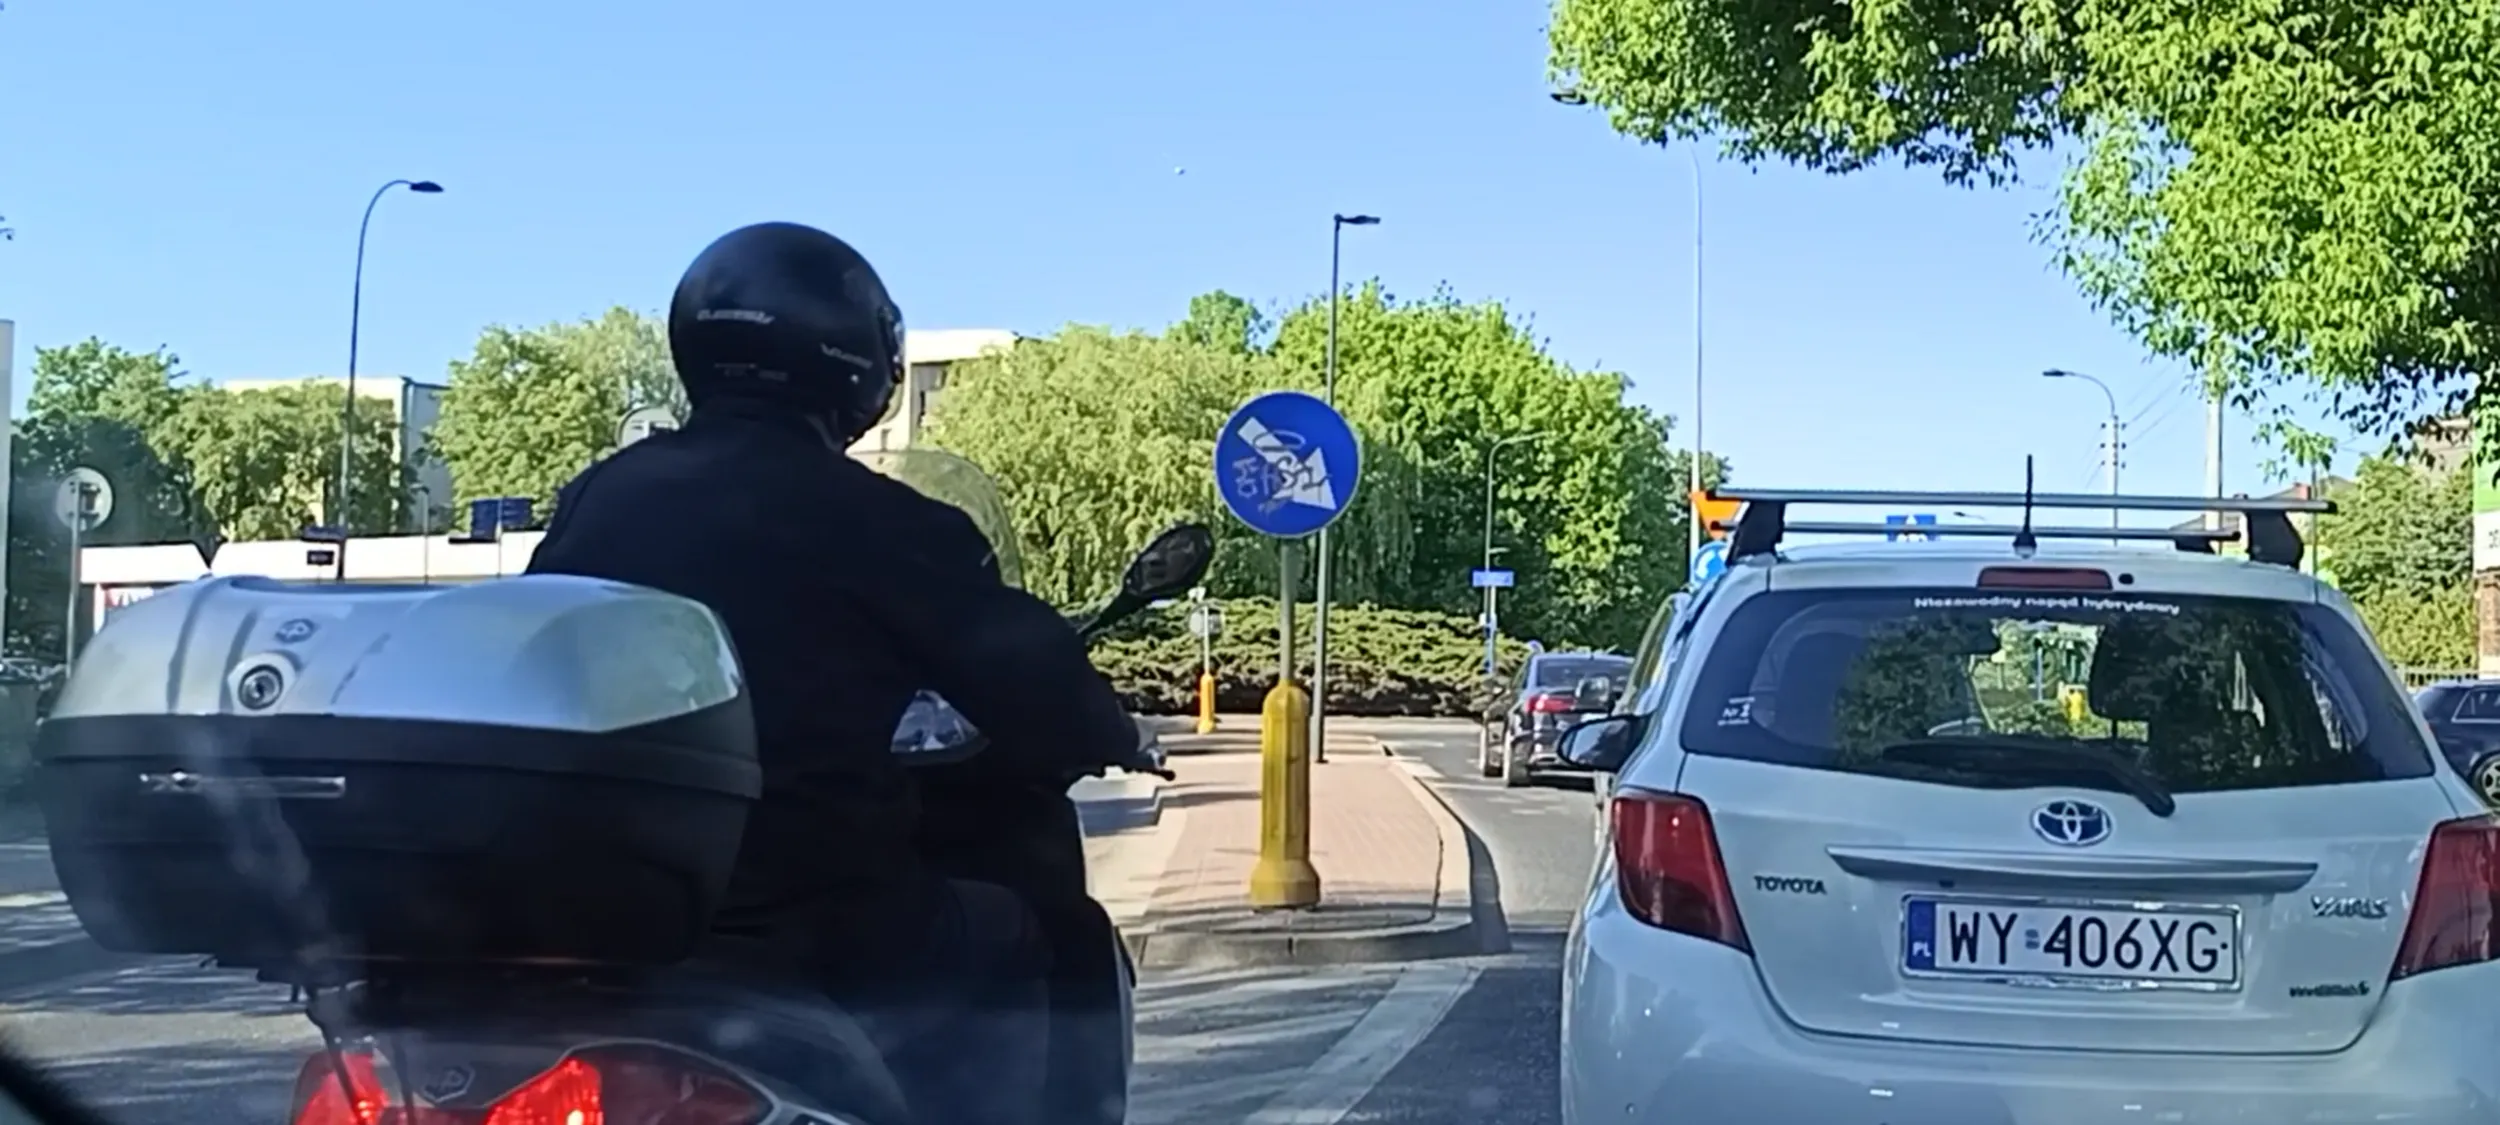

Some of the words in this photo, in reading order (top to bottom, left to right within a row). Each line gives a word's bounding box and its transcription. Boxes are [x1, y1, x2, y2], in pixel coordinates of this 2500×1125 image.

[1753, 875, 1827, 896] TOYOTA
[1911, 941, 1932, 957] PL
[1949, 911, 2018, 965] WY
[2043, 914, 2219, 973] 406XG
